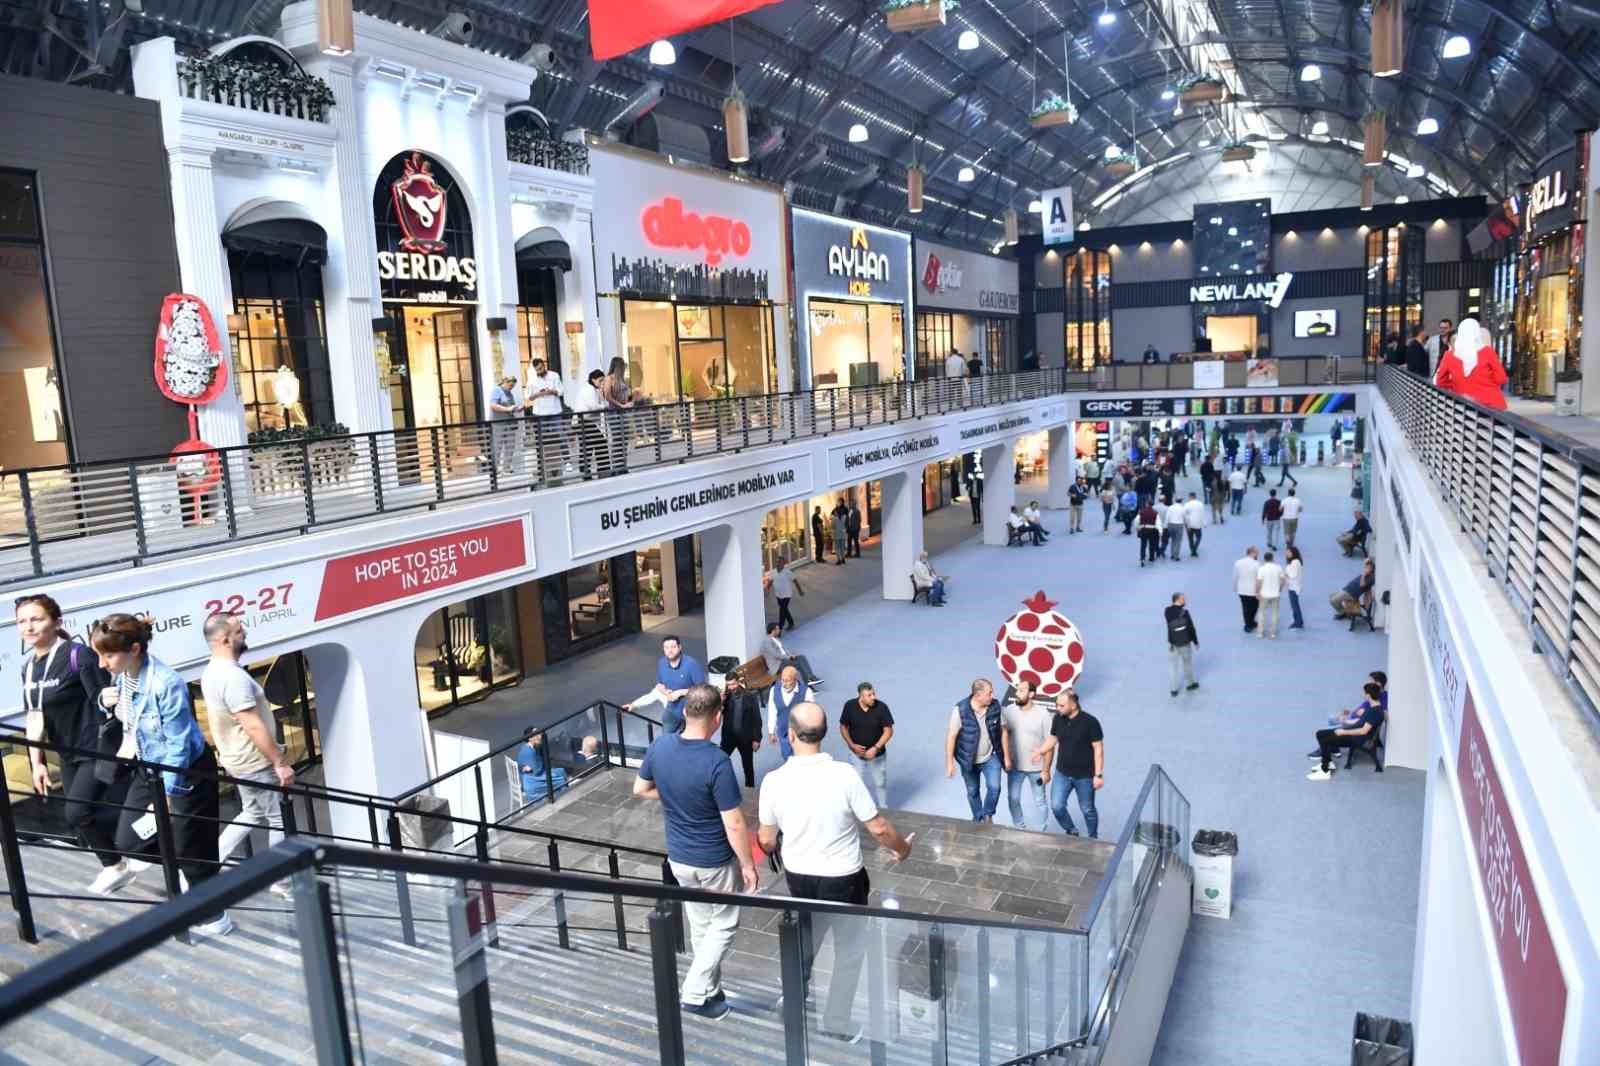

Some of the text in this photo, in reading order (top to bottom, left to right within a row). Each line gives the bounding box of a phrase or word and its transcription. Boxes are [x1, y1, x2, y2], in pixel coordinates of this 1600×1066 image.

[1050, 197, 1066, 224] A
[378, 251, 476, 291] SERDAŞ
[829, 246, 889, 280] AYHAN
[850, 281, 871, 296] HOME
[1086, 400, 1133, 413] GENÇ
[600, 469, 795, 530] BU ŞEHRİN GENLERİNDE MOBİLYA VAR
[354, 536, 489, 583] HOPE TO SEE YOU
[401, 562, 457, 590] IN 2024
[205, 583, 294, 617] 22-27
[259, 607, 297, 623] APRIL
[1510, 860, 1531, 964] YOU
